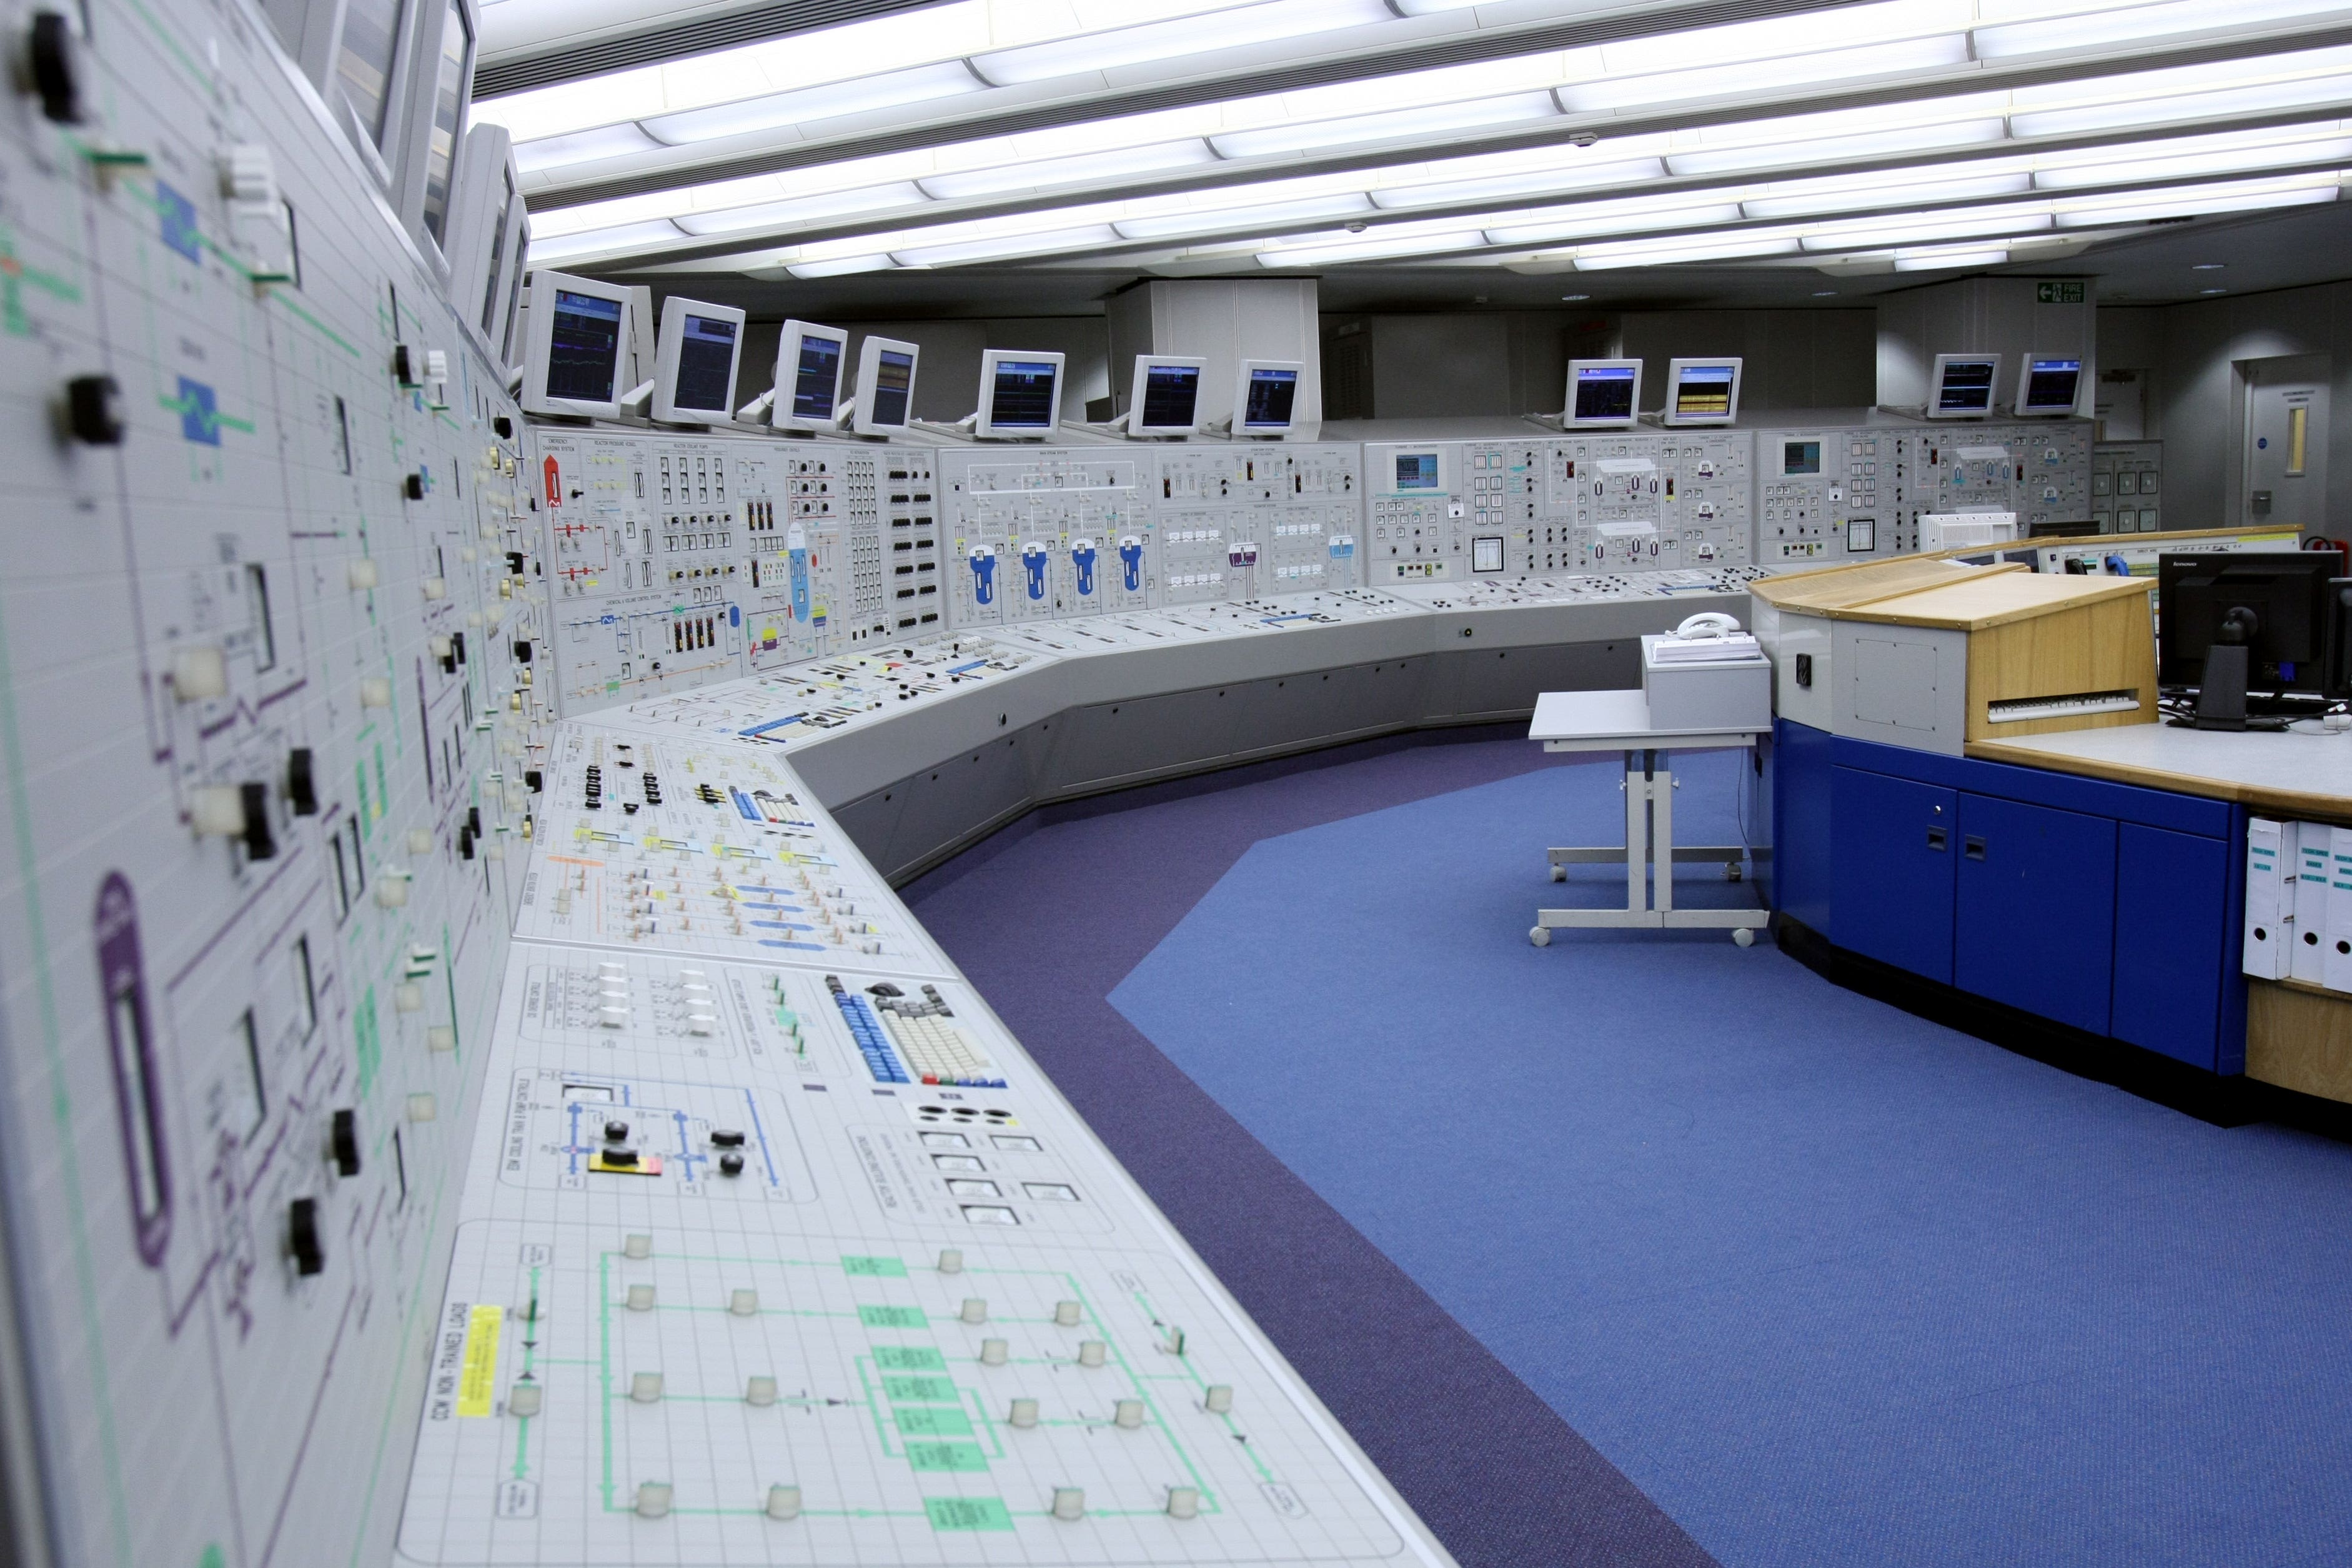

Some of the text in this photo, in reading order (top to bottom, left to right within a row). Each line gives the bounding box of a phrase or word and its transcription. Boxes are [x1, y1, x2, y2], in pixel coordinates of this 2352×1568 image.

[2064, 284, 2082, 292] FIRE
[2064, 294, 2081, 302] EXIT
[449, 1303, 468, 1329] LOADS
